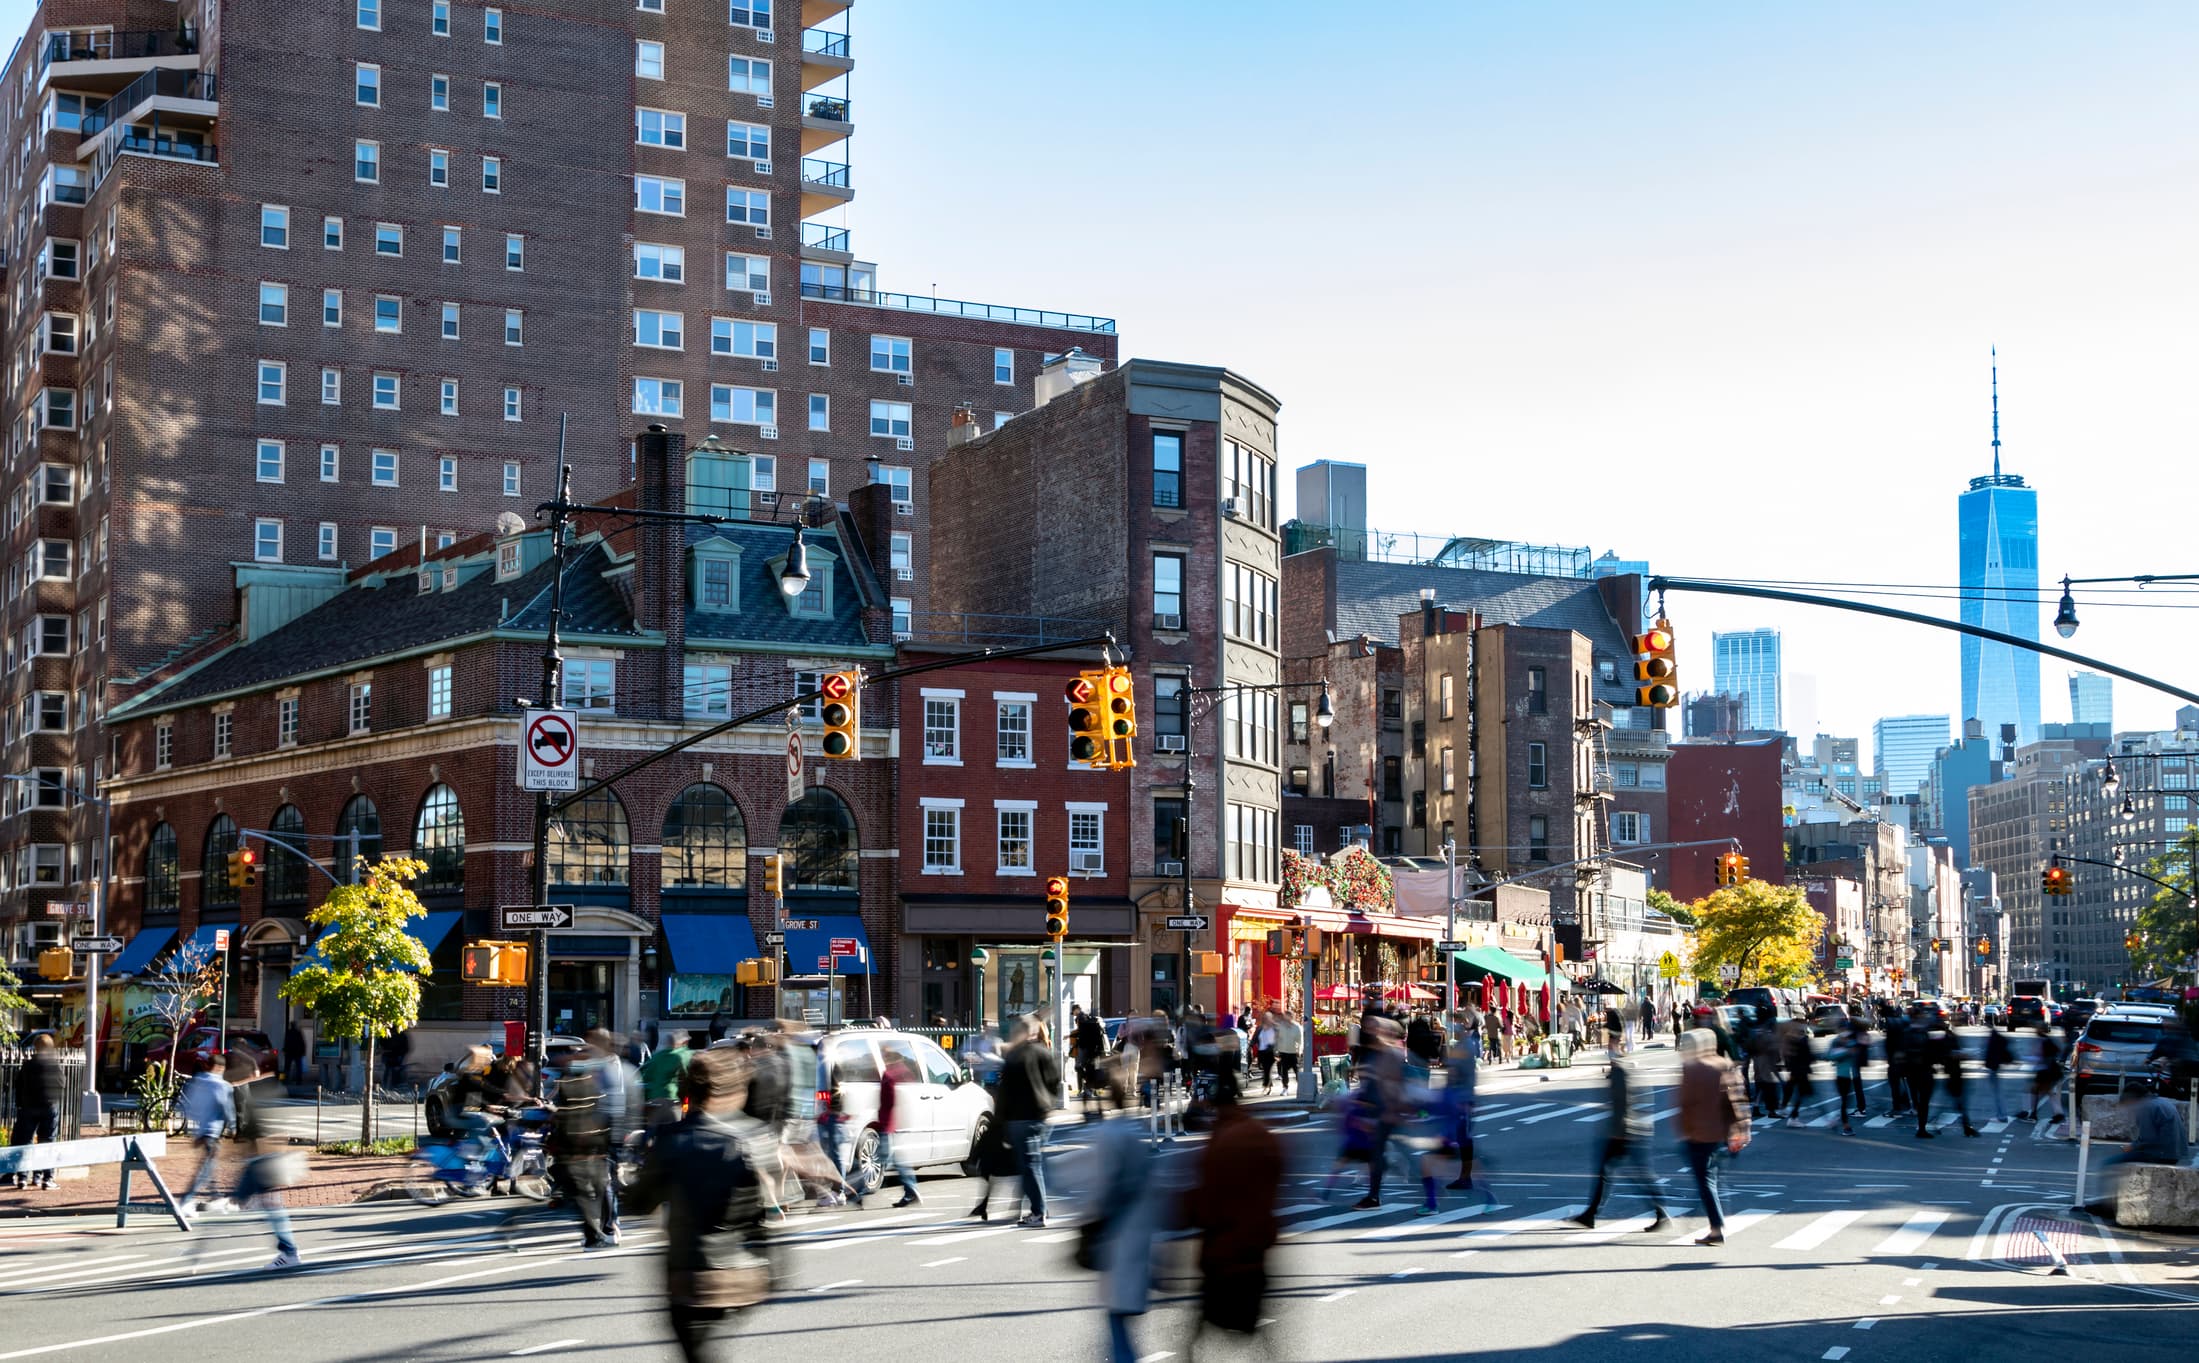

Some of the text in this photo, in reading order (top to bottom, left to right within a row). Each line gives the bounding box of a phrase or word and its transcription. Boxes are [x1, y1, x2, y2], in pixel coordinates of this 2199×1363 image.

[527, 769, 574, 778] EXCEPT DELIVERIES
[533, 778, 569, 787] THIS BLOCK
[49, 903, 86, 914] GROVE ST
[511, 912, 562, 923] ONE WAY
[785, 920, 818, 929] GROVE ST
[75, 940, 117, 949] ONE WAY
